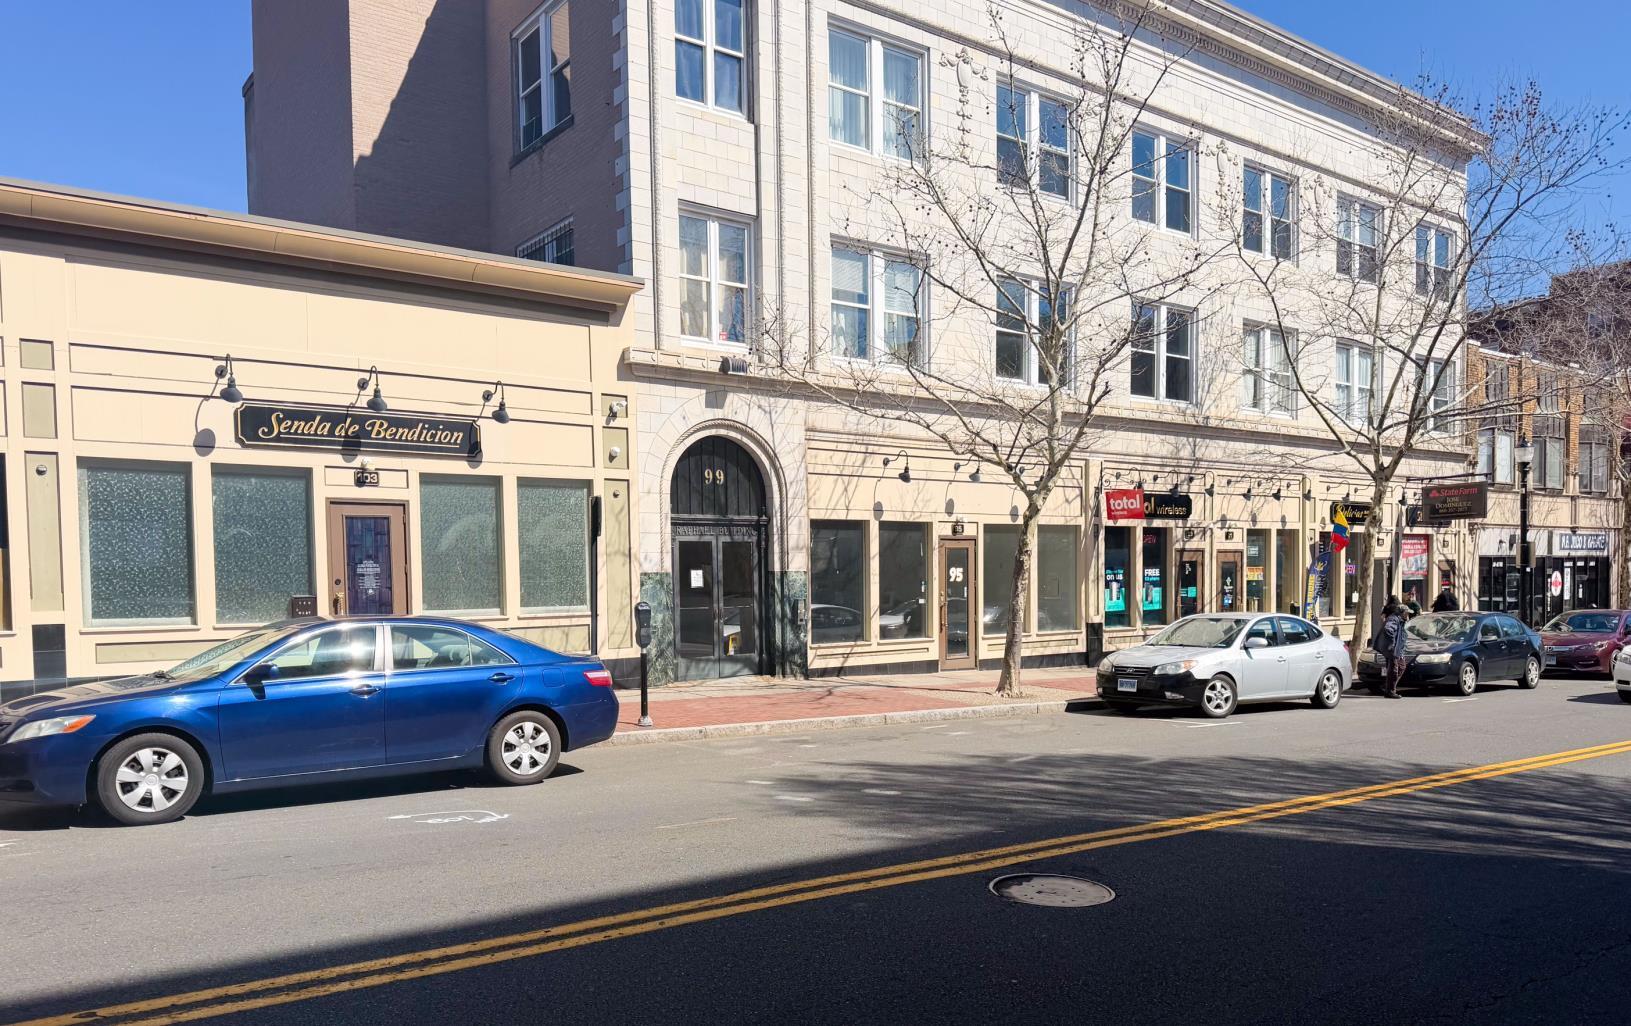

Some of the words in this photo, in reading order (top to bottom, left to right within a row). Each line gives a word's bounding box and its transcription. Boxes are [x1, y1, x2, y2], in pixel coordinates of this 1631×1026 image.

[258, 412, 331, 439] Senda
[335, 417, 359, 436] de
[364, 419, 464, 444] Bendicion
[356, 473, 378, 483] 103
[704, 468, 725, 485] 99
[1109, 494, 1141, 510] total
[1156, 504, 1187, 515] wireless
[676, 525, 715, 536] RAPHAEL
[949, 566, 964, 582] 95
[1144, 568, 1160, 577] FREE
